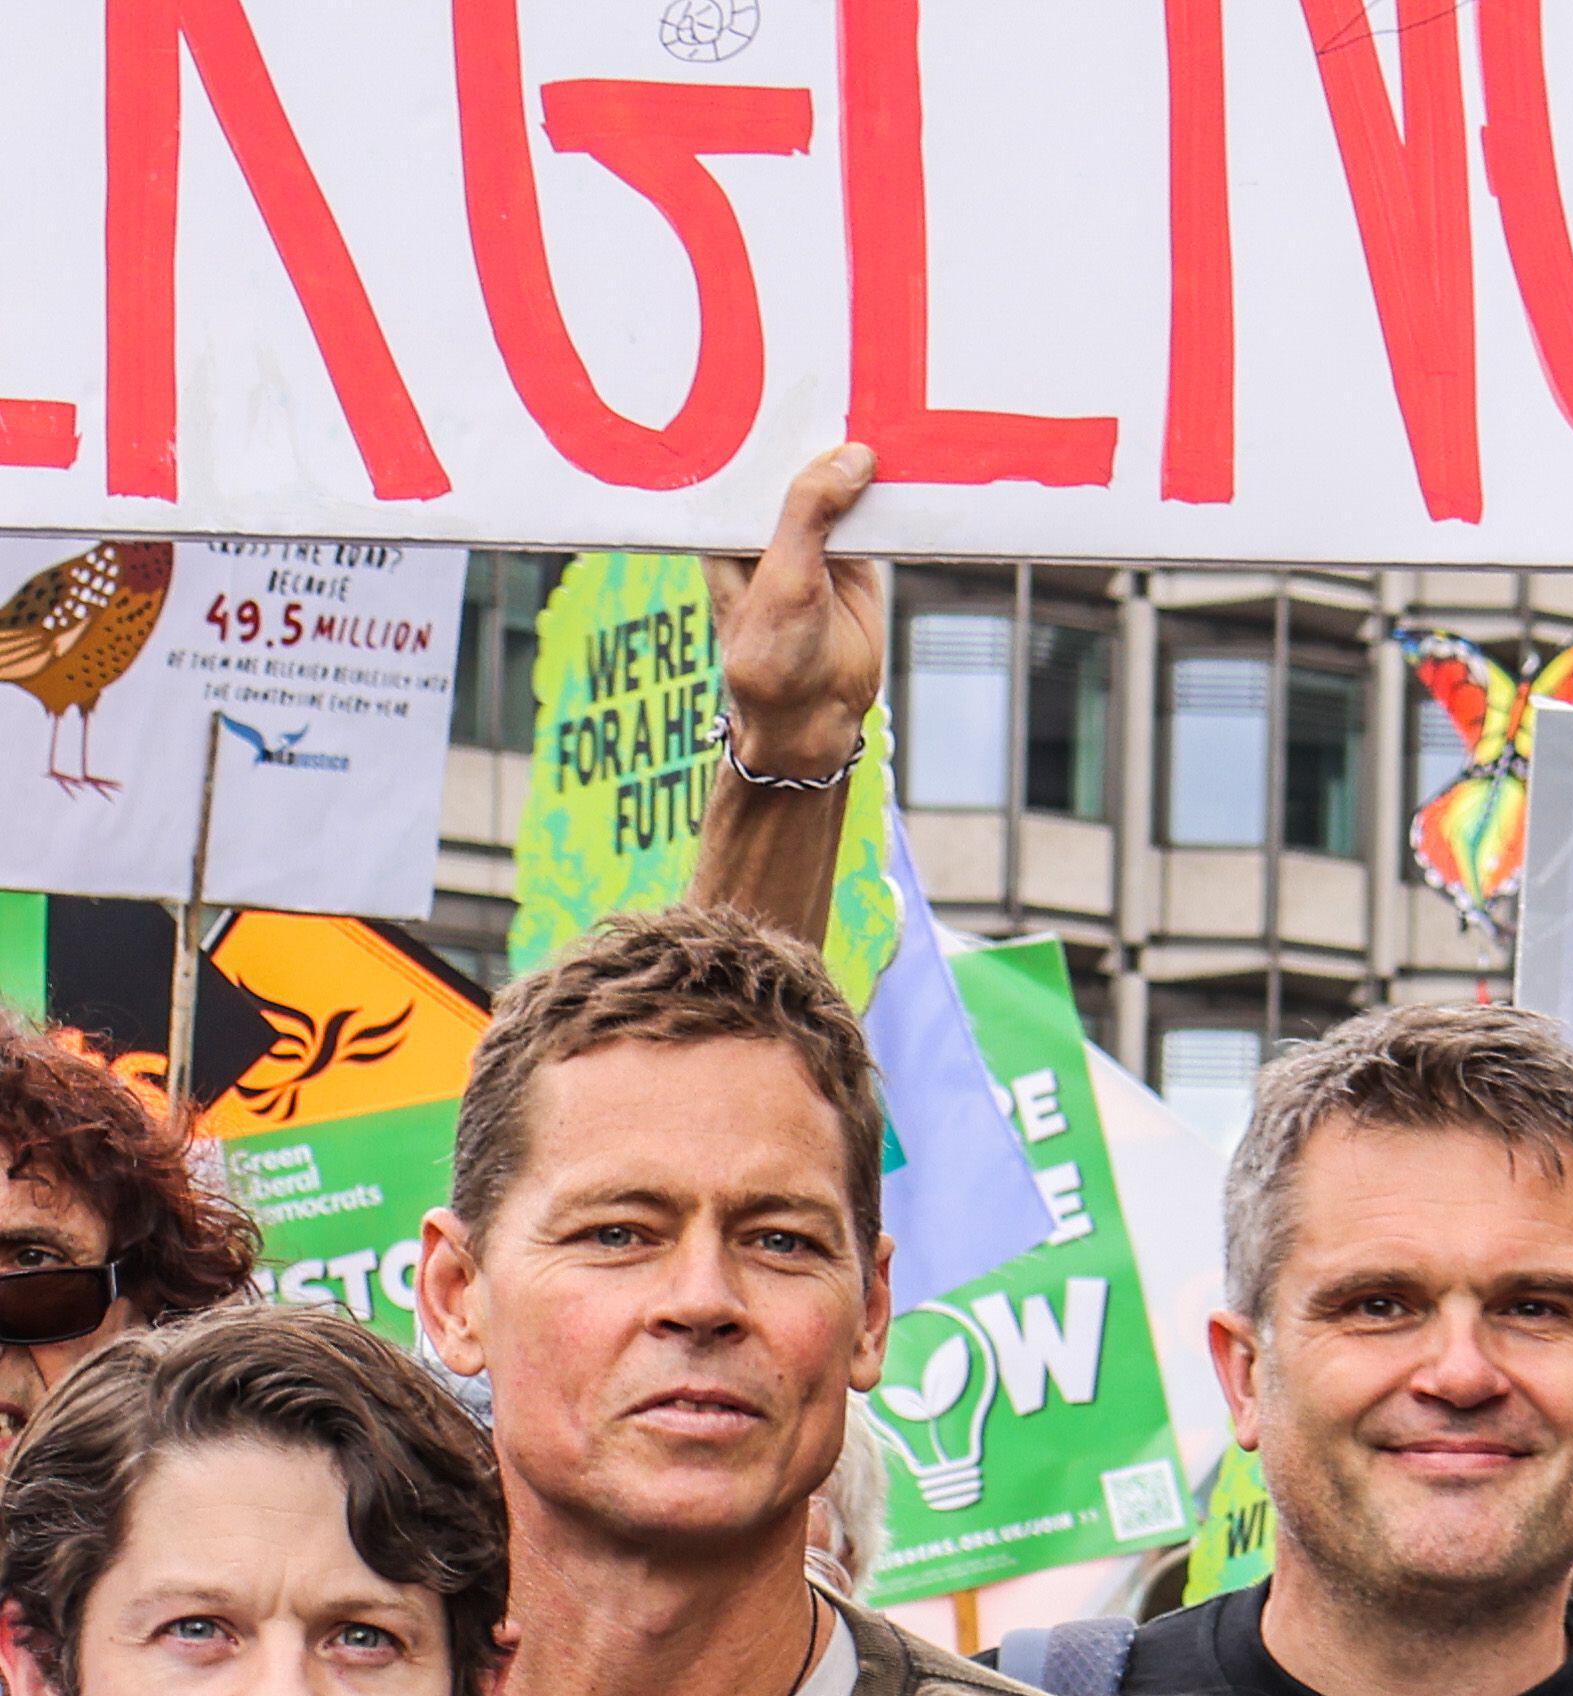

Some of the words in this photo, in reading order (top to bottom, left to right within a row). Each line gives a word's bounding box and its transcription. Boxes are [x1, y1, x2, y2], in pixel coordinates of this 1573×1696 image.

[268, 569, 350, 603] BECAUSE
[206, 593, 304, 650] 49.5
[311, 613, 434, 654] MILLION
[586, 603, 696, 702] WE'RE
[558, 707, 623, 795] FOR
[631, 699, 654, 773] A
[663, 681, 725, 764] HE
[231, 1142, 313, 1176] Green
